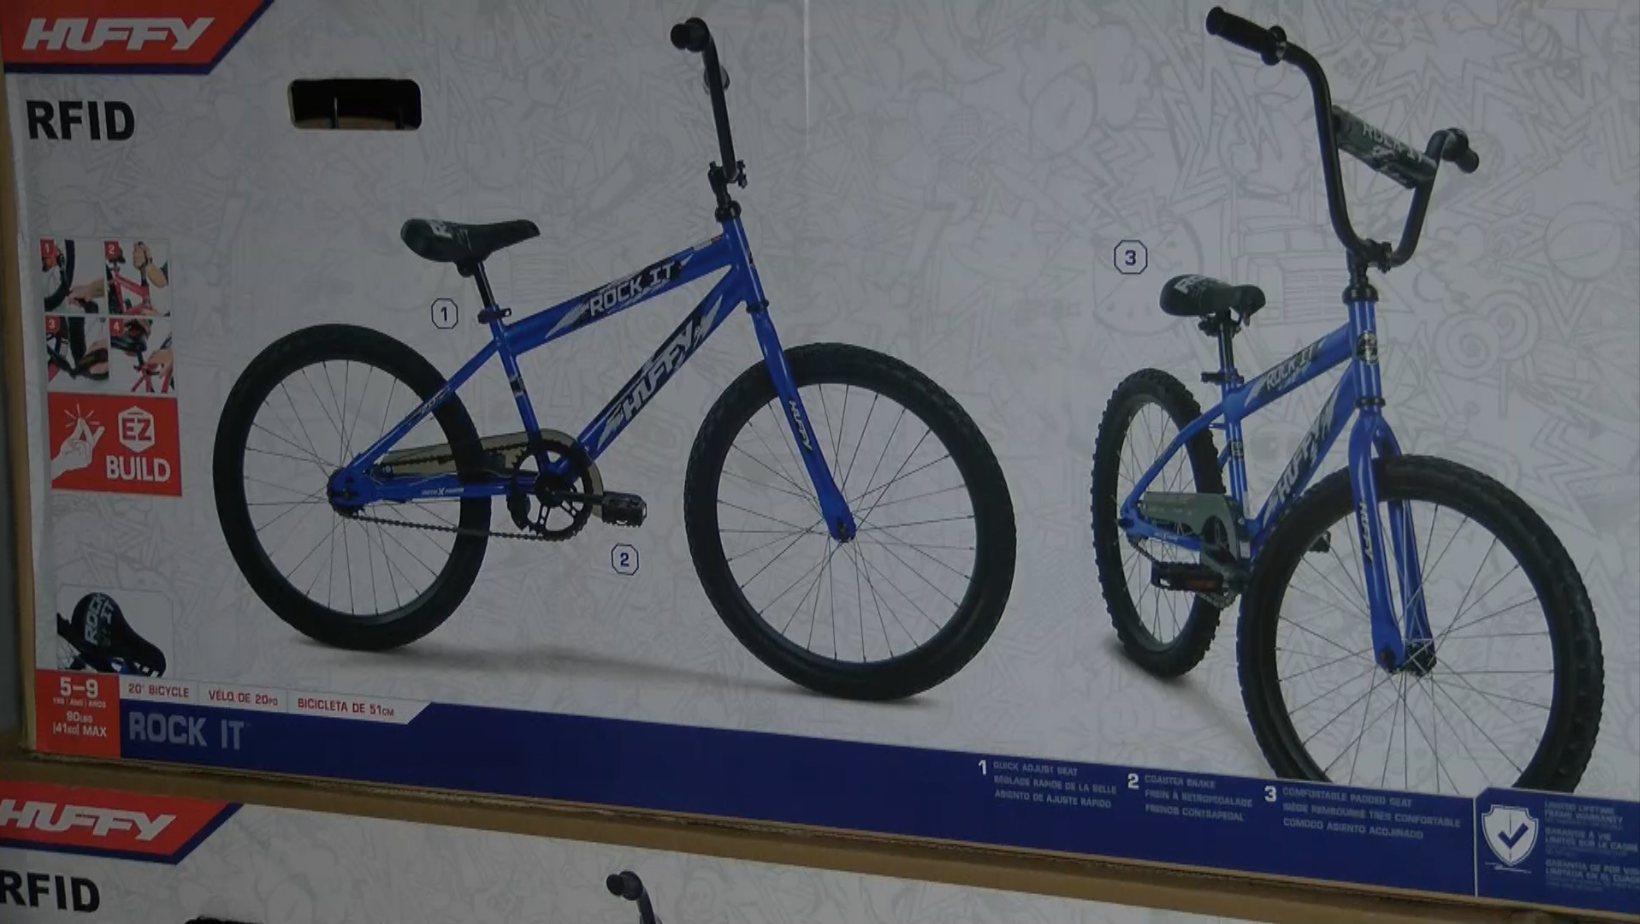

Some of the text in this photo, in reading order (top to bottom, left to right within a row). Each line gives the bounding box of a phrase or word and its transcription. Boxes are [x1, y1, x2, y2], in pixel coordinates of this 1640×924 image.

[22, 17, 214, 51] HUFFY
[26, 100, 135, 140] RFID
[1125, 250, 1137, 265] 3
[589, 260, 676, 317] ROCK IT
[440, 306, 449, 322] 1
[620, 318, 694, 422] HUFFY
[1266, 362, 1296, 392] ROCK
[122, 417, 152, 441] EZ
[106, 455, 171, 483] BUILD
[619, 552, 630, 567] 2
[60, 676, 98, 699] 5-9
[149, 685, 189, 698] BICYCLE
[238, 693, 251, 703] DE
[298, 698, 348, 713] BICICLETA
[352, 703, 365, 713] DE
[83, 725, 107, 738] MAX
[128, 711, 245, 750] ROCK IT
[978, 760, 987, 776] 1
[1127, 773, 1139, 790] 2
[1264, 785, 1277, 802] 3
[0, 799, 176, 841] HUFFY
[0, 870, 100, 913] RFID
